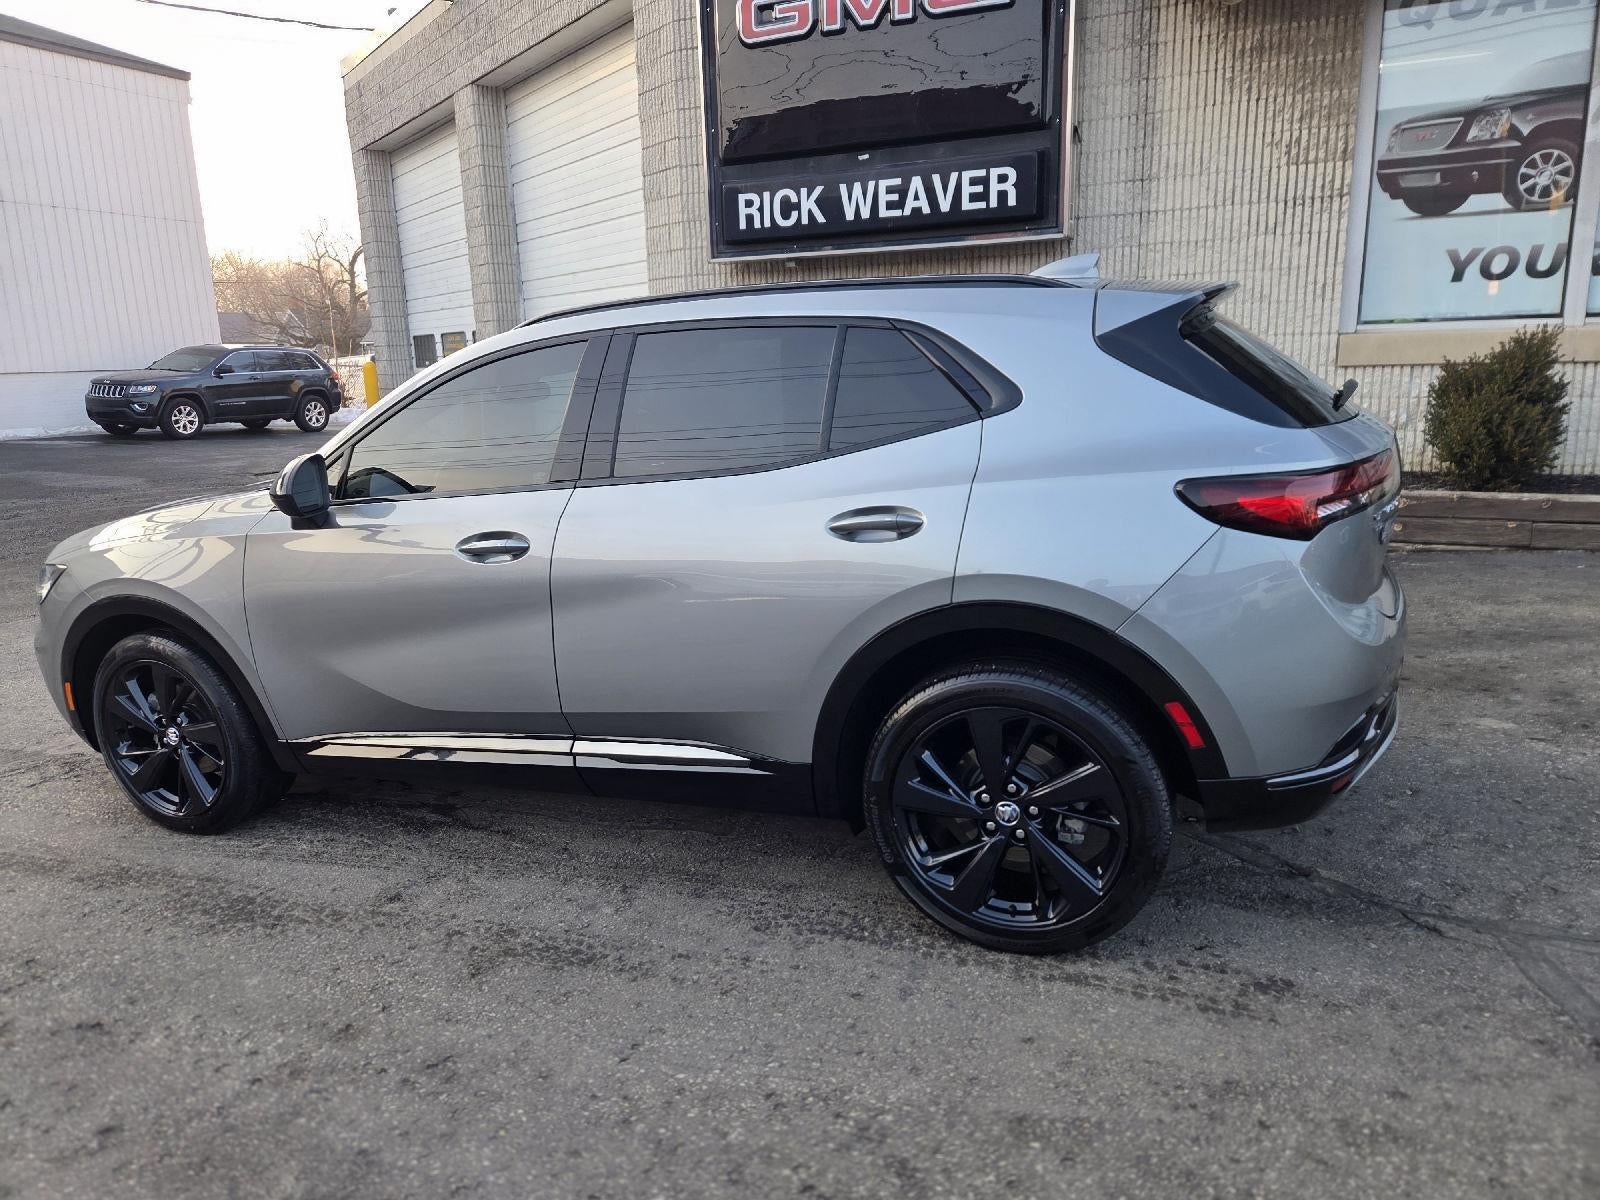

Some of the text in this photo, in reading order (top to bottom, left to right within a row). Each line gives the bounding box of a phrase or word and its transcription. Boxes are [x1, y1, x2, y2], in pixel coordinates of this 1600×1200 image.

[736, 0, 1015, 47] GM
[1398, 0, 1582, 30] QU
[738, 166, 1017, 230] RICK WEAVER
[1446, 243, 1568, 283] YOU
